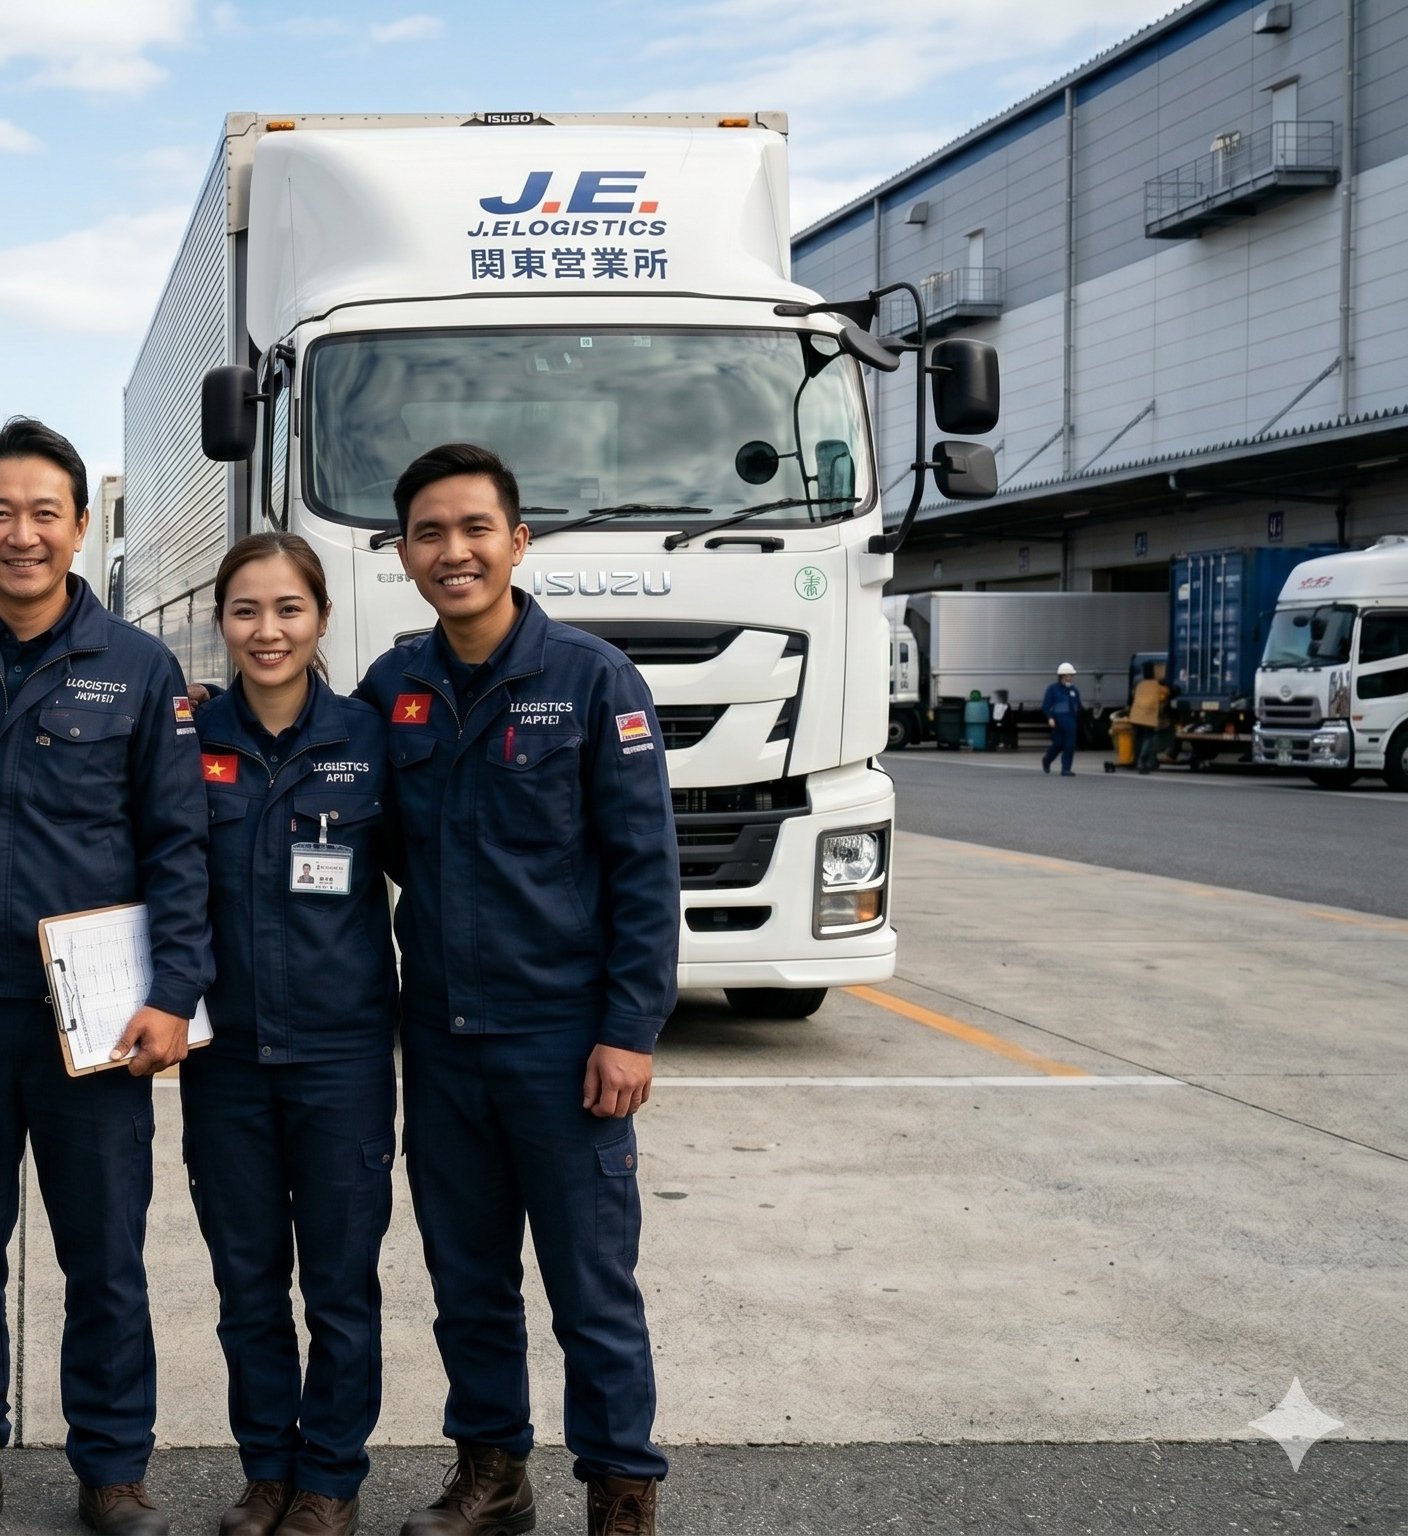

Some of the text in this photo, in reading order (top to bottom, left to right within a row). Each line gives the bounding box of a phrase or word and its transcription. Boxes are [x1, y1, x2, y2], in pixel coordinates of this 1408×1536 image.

[479, 171, 659, 215] J.E.
[467, 220, 667, 237] J.ELOGISTICS
[470, 247, 668, 280] 関東営業所
[532, 570, 672, 598] ISUZU
